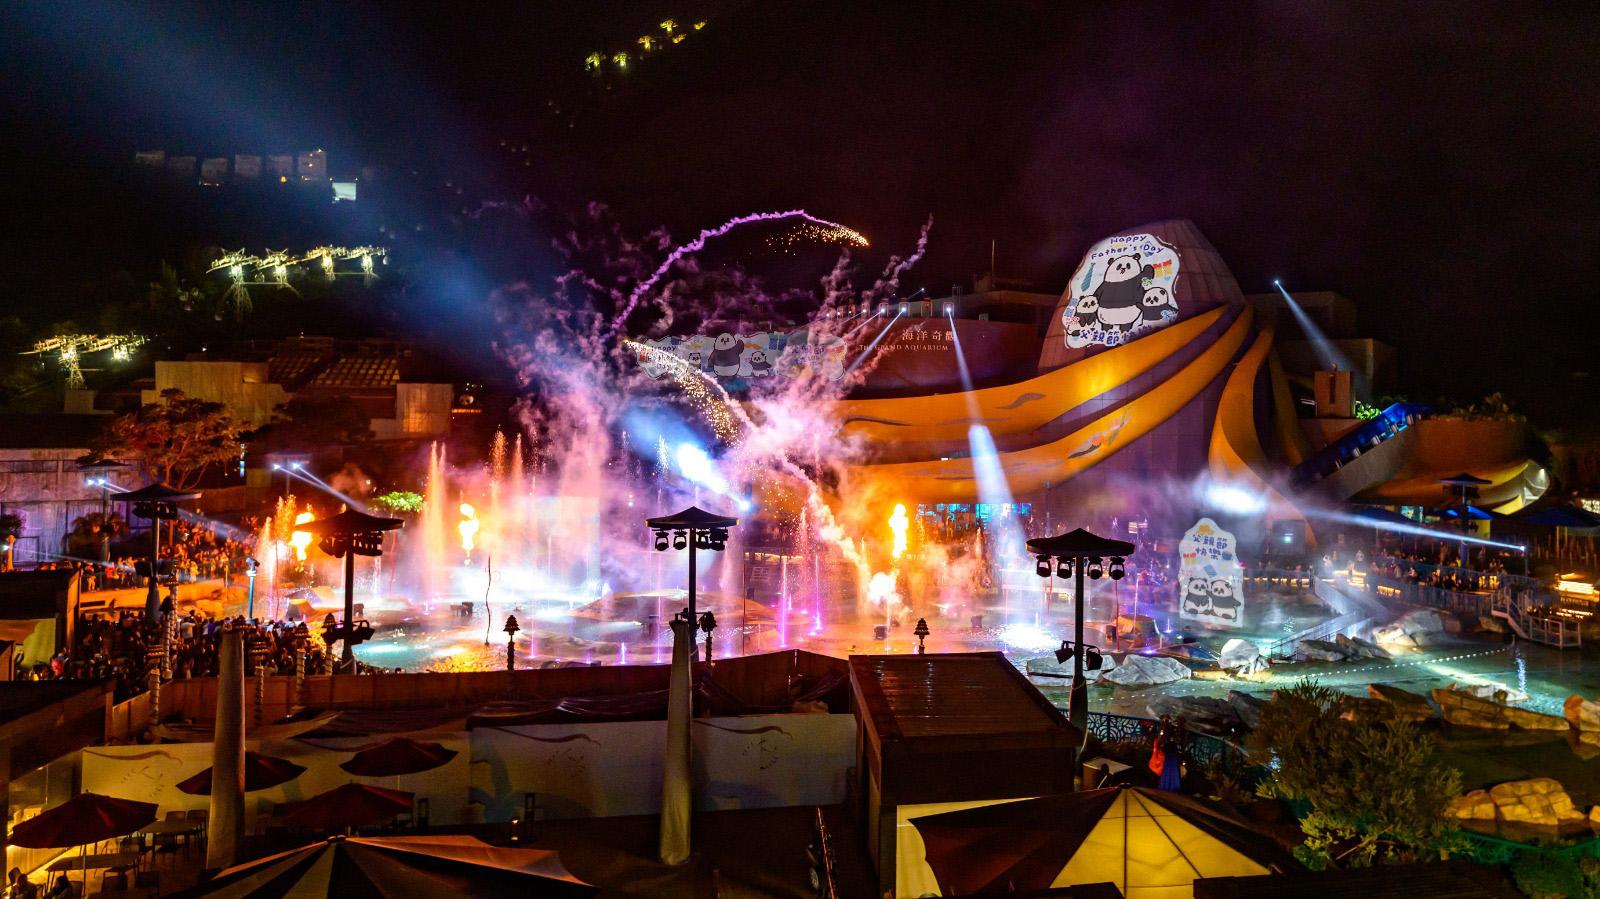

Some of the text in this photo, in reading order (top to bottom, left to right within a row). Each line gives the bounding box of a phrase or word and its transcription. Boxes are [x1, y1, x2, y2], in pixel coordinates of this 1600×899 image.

[1110, 235, 1147, 245] Happy
[1091, 240, 1164, 260] Father's Day
